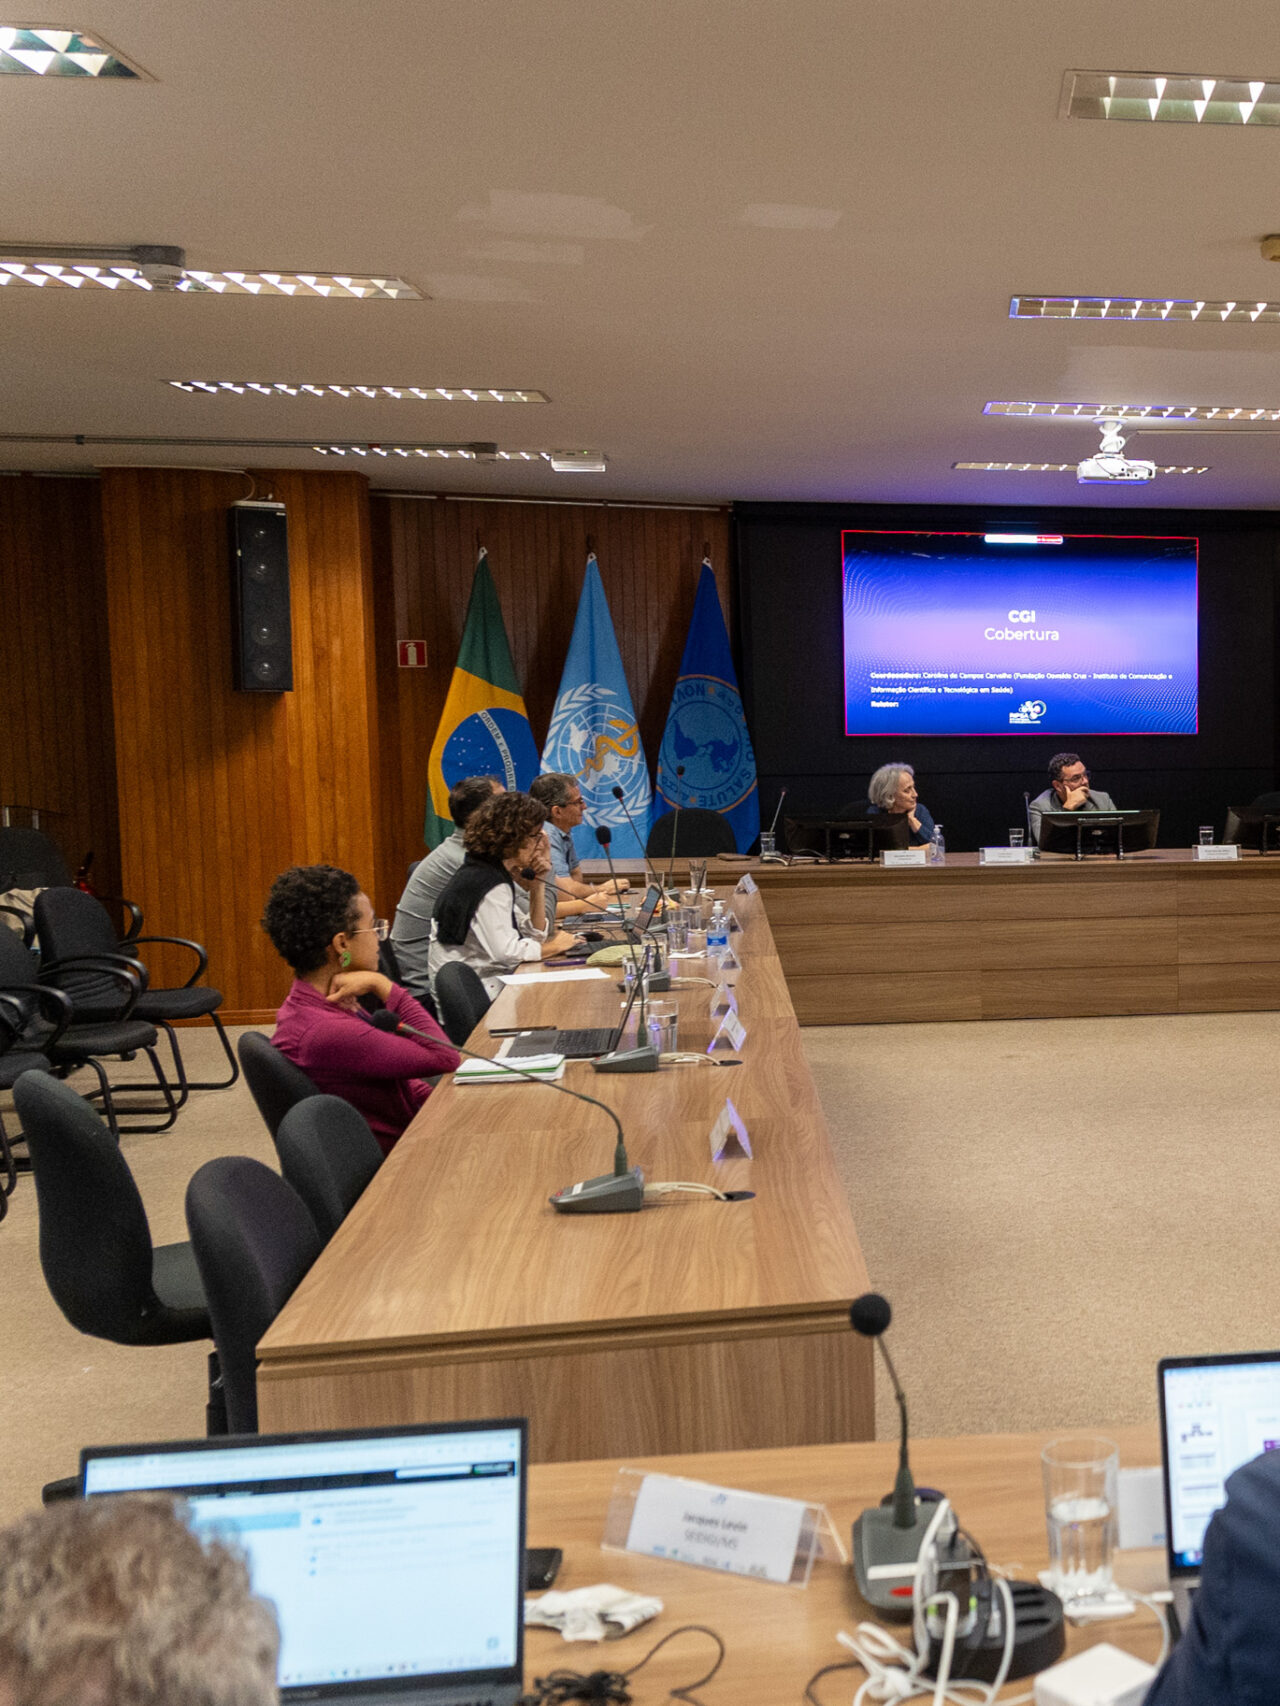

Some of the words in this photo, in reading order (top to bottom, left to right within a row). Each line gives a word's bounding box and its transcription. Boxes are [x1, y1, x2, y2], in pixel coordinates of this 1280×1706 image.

[1008, 610, 1036, 623] CGI
[984, 627, 1060, 641] Cobertura
[959, 672, 984, 680] Campos
[1128, 673, 1167, 681] Comunicação
[870, 686, 906, 694] Informação
[943, 686, 978, 694] Tecnológica
[481, 712, 501, 740] ORDEM
[698, 768, 752, 807] SALUTE
